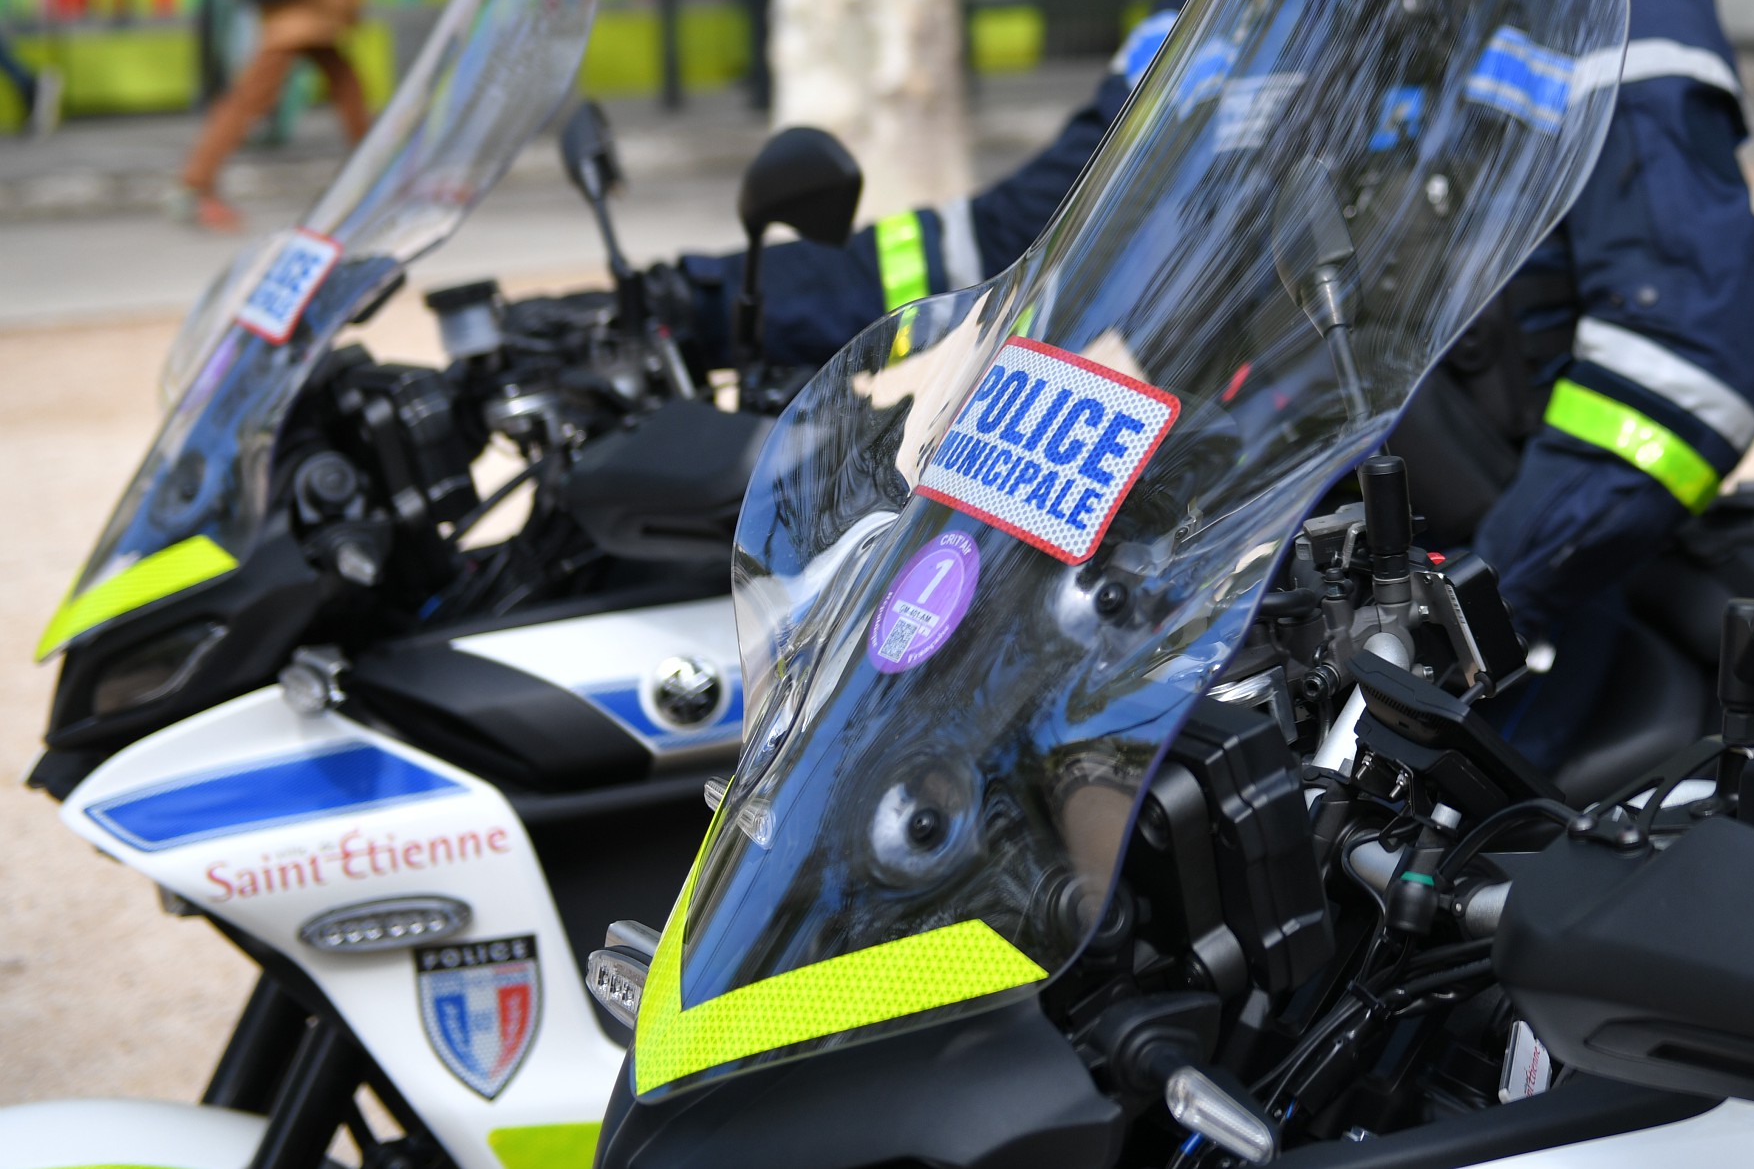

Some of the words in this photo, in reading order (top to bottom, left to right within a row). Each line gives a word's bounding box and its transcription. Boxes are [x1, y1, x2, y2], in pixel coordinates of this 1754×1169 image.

[957, 365, 1145, 487] POLICE
[931, 430, 1103, 531] MUNICIPALE
[916, 559, 955, 604] 1
[423, 939, 527, 970] POLICE
